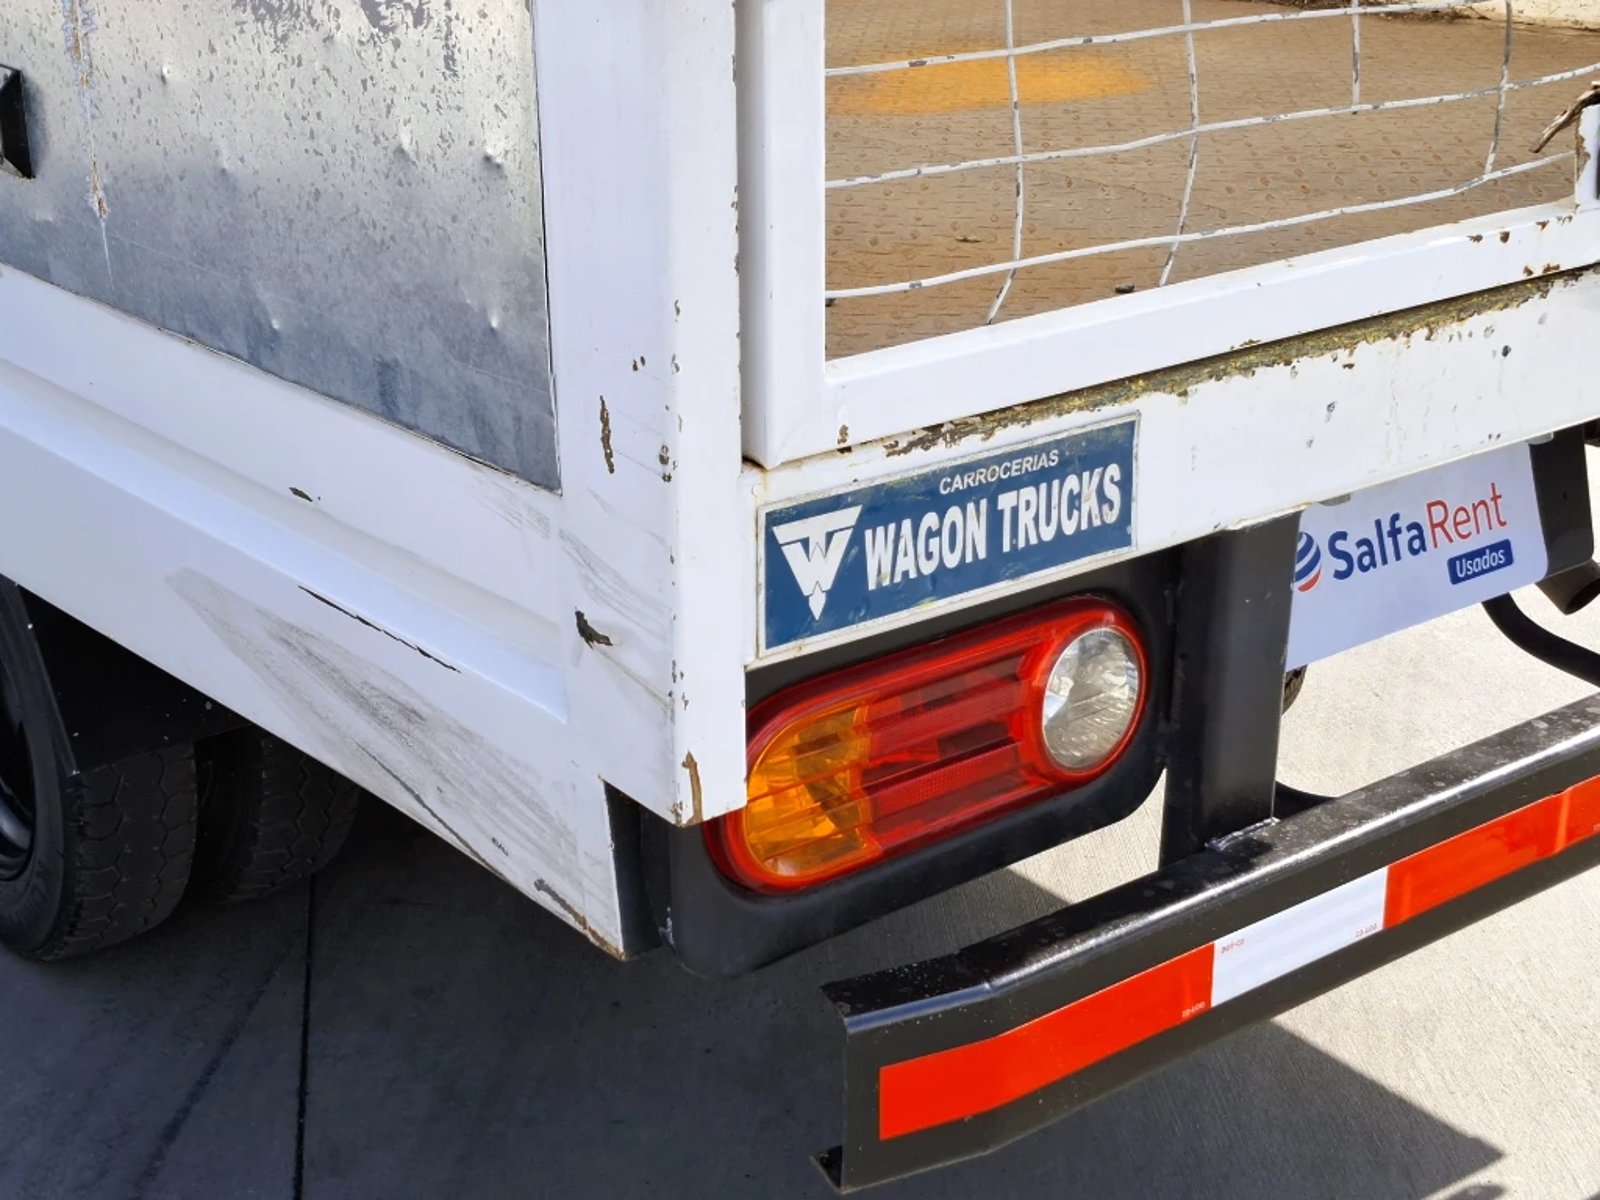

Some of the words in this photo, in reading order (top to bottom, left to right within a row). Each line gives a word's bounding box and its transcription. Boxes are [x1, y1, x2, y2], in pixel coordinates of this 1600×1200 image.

[939, 449, 1060, 494] CARROCERIAS
[864, 498, 987, 591] WAGON
[998, 463, 1122, 553] TRUCKS
[1456, 548, 1505, 579] Usados
